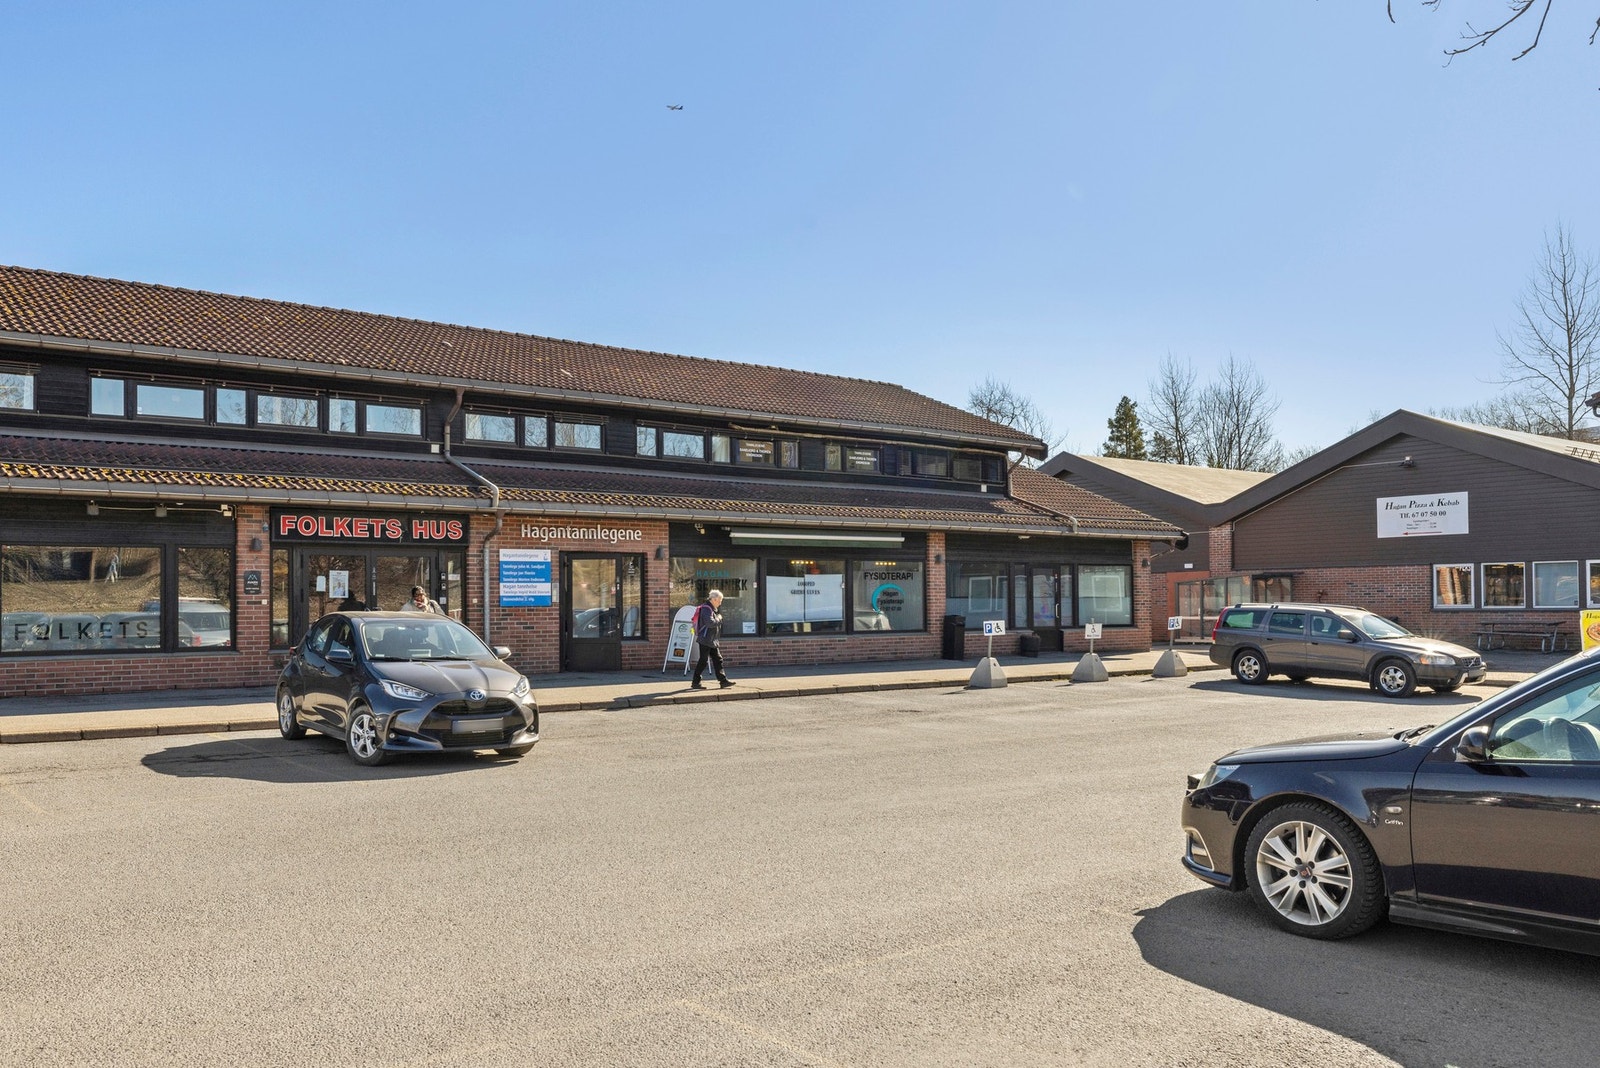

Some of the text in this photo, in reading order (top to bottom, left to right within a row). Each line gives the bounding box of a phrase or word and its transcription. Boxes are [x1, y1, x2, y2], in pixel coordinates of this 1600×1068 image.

[1385, 501, 1407, 510] Hagan
[1409, 500, 1427, 509] Pizza
[1437, 498, 1460, 507] Kebab
[280, 515, 463, 540] FOLKETS HUS
[521, 524, 643, 543] Hagantannlegene
[863, 571, 914, 580] FYSIOTERAPI
[14, 621, 148, 641] FOLKETS
[1384, 818, 1404, 826] Griffin
